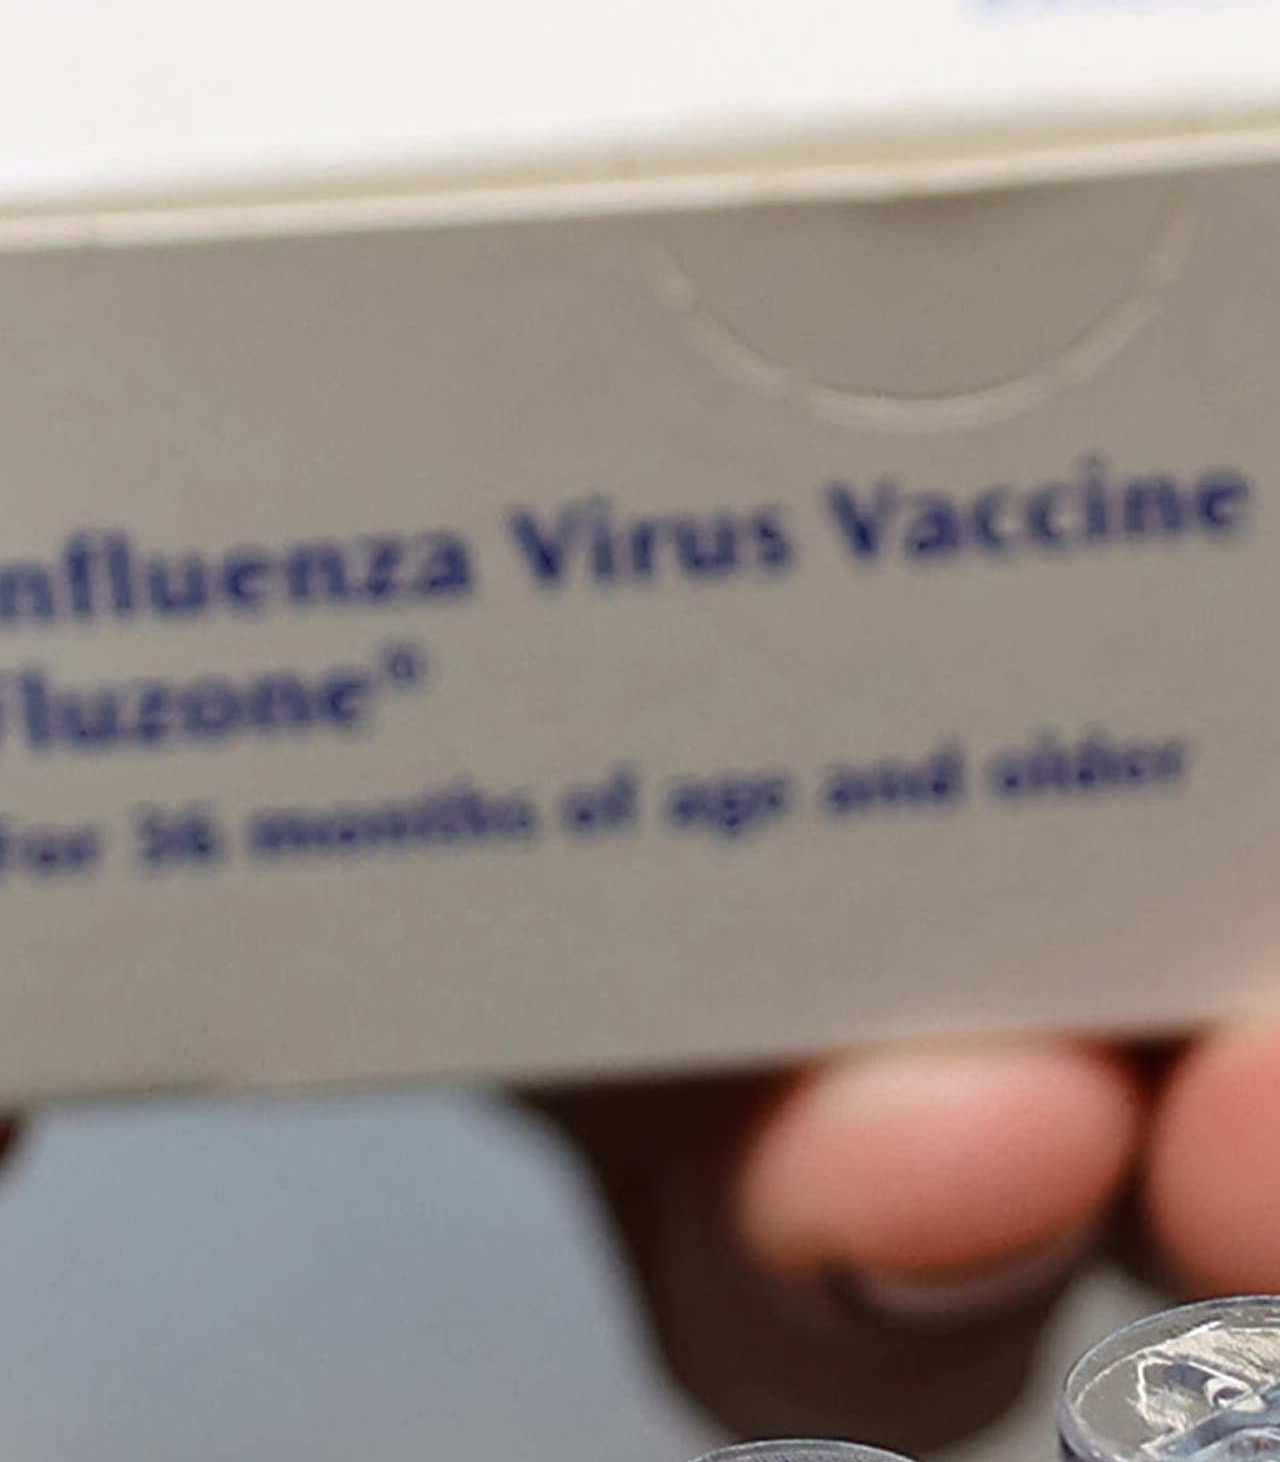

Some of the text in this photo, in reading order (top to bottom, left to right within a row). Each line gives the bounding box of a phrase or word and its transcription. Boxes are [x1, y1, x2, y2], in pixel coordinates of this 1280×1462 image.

[509, 500, 794, 589] Virus
[827, 460, 1250, 564] Vaccine
[245, 784, 541, 862] months
[559, 769, 639, 838] of
[664, 776, 793, 841] age
[820, 747, 967, 819] and
[986, 734, 1186, 802] older
